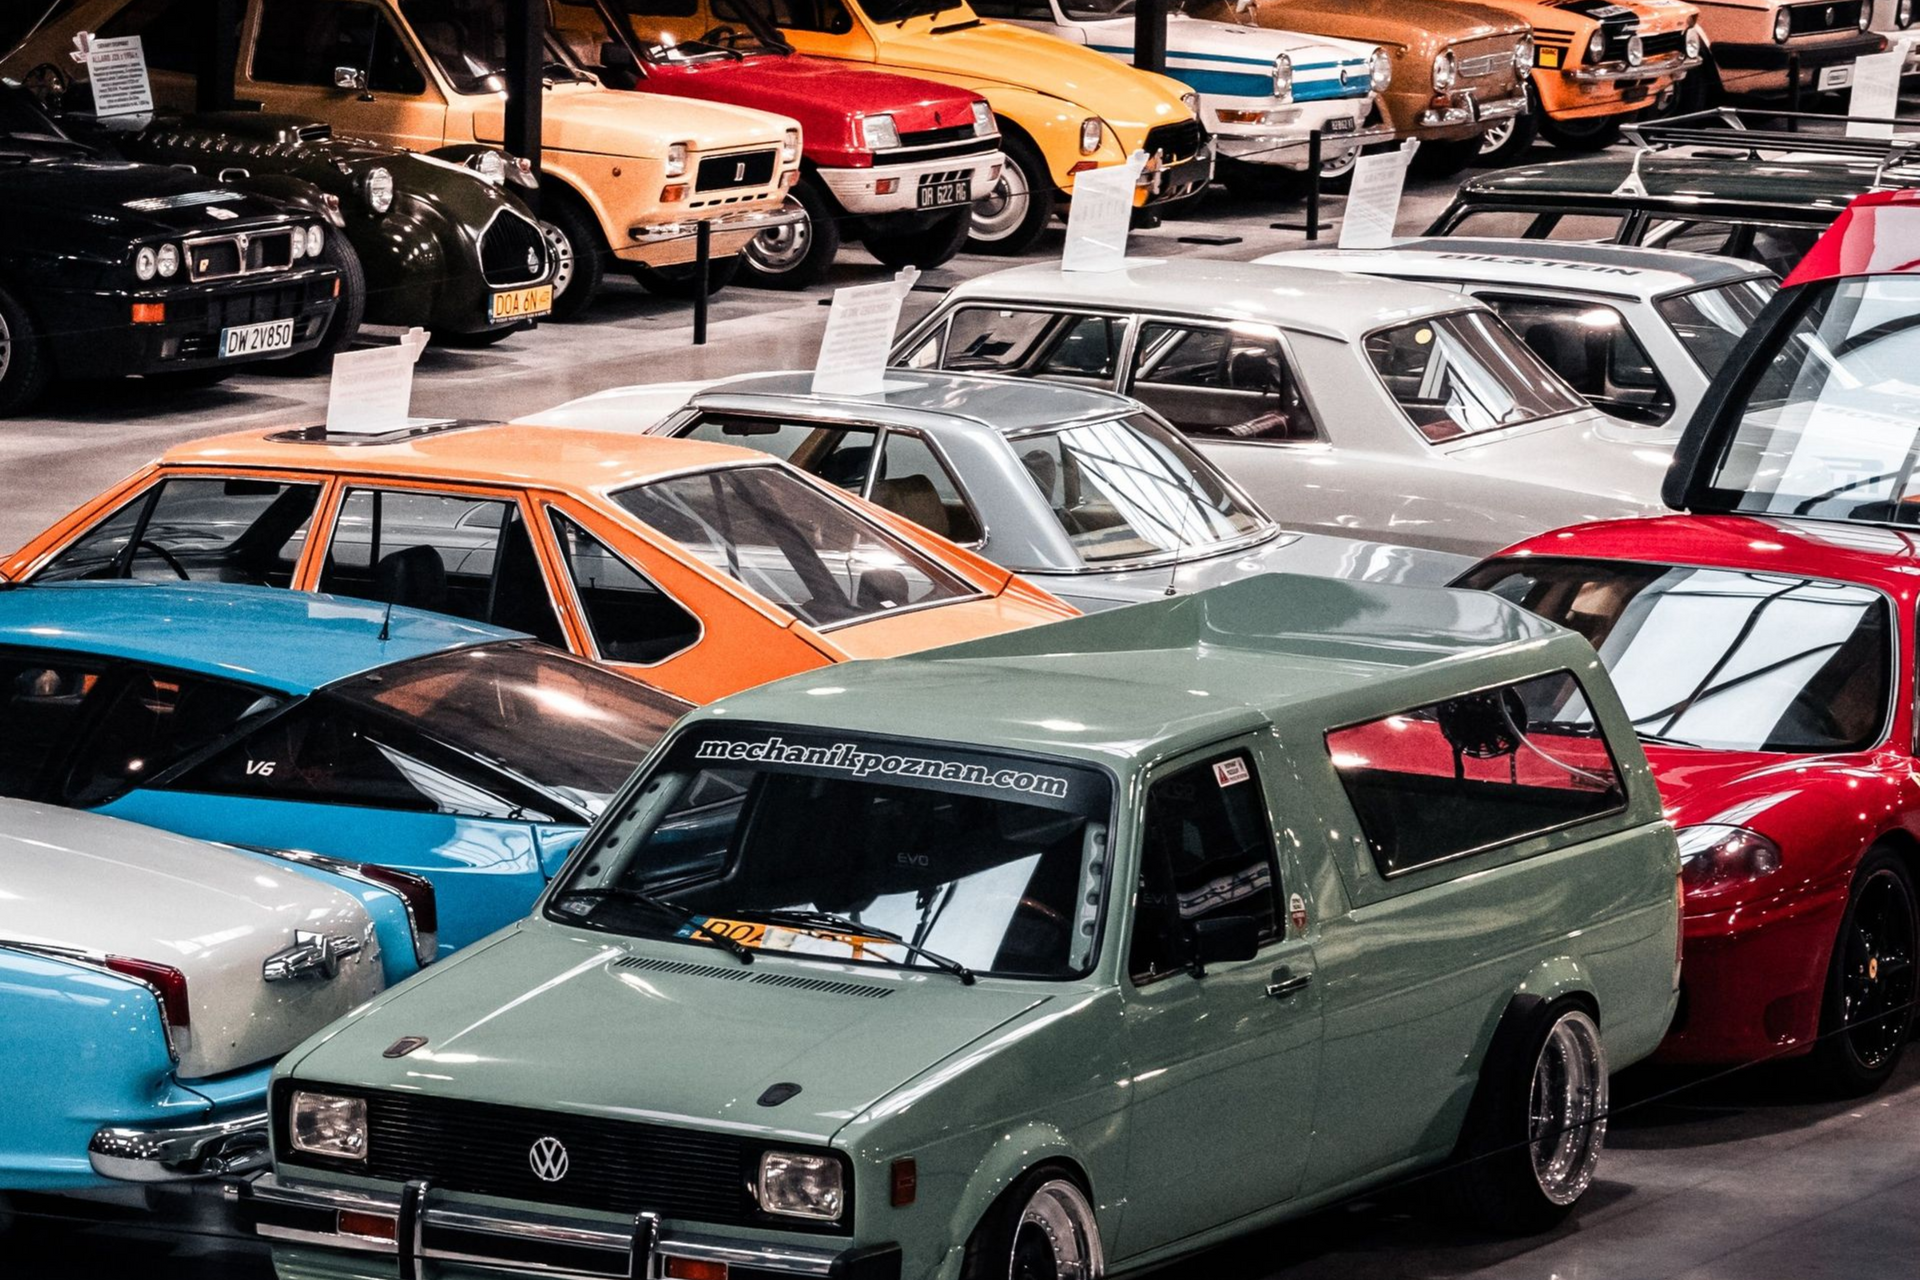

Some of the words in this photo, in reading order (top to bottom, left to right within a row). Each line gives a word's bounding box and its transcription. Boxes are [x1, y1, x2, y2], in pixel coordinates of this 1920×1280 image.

[937, 184, 953, 204] 622
[1437, 254, 1642, 276] BILSTEIN
[496, 294, 519, 316] DOA
[524, 290, 538, 312] 6N
[228, 329, 249, 353] DW
[251, 324, 290, 349] 2V850
[246, 760, 277, 776] V6
[696, 738, 1067, 798] mechanikpoznan.com
[897, 852, 929, 866] EVO
